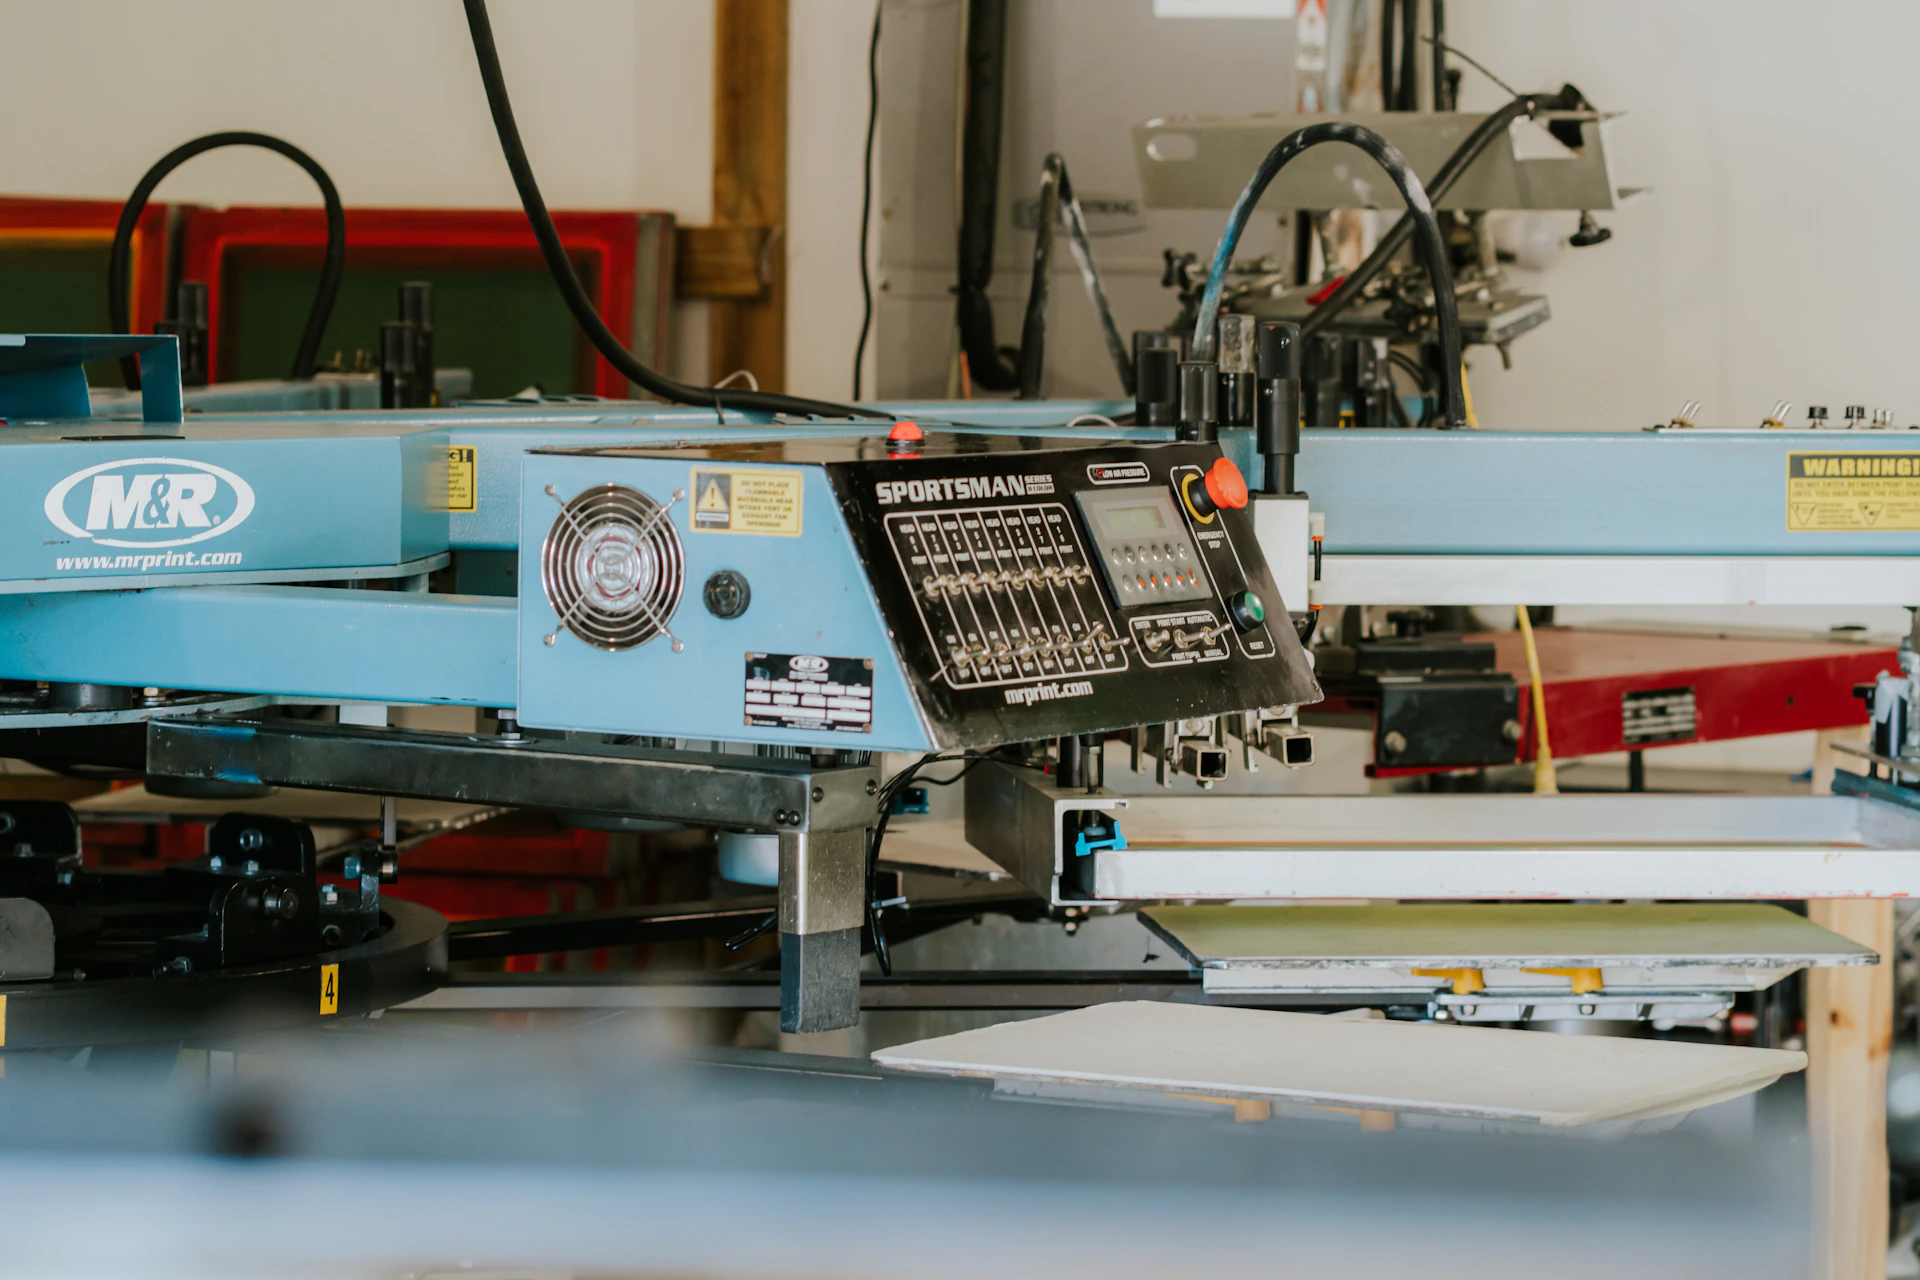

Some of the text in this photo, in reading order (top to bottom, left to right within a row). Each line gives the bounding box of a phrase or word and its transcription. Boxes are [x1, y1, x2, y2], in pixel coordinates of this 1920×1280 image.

[1803, 458, 1920, 476] WARNING!
[875, 474, 1053, 505] SPORTSMAN SERIES
[899, 514, 1062, 533] HEAD HEAD HEAD HEAD HEAD HEAD HEAD HEAD
[1197, 530, 1225, 540] EMERGENCY
[1208, 540, 1220, 549] STOP
[56, 550, 242, 572] www.mrprint.com
[1134, 620, 1151, 629] ENTER
[1170, 617, 1186, 626] START
[1186, 615, 1213, 624] AUTOMATIC
[1204, 648, 1224, 657] MANUAL
[1249, 641, 1265, 650] RESET
[959, 653, 1115, 678] OFF OFF OFF OFF OFF OFF OFF OFF
[1004, 680, 1094, 706] mrprint.com
[325, 971, 335, 1005] 4
